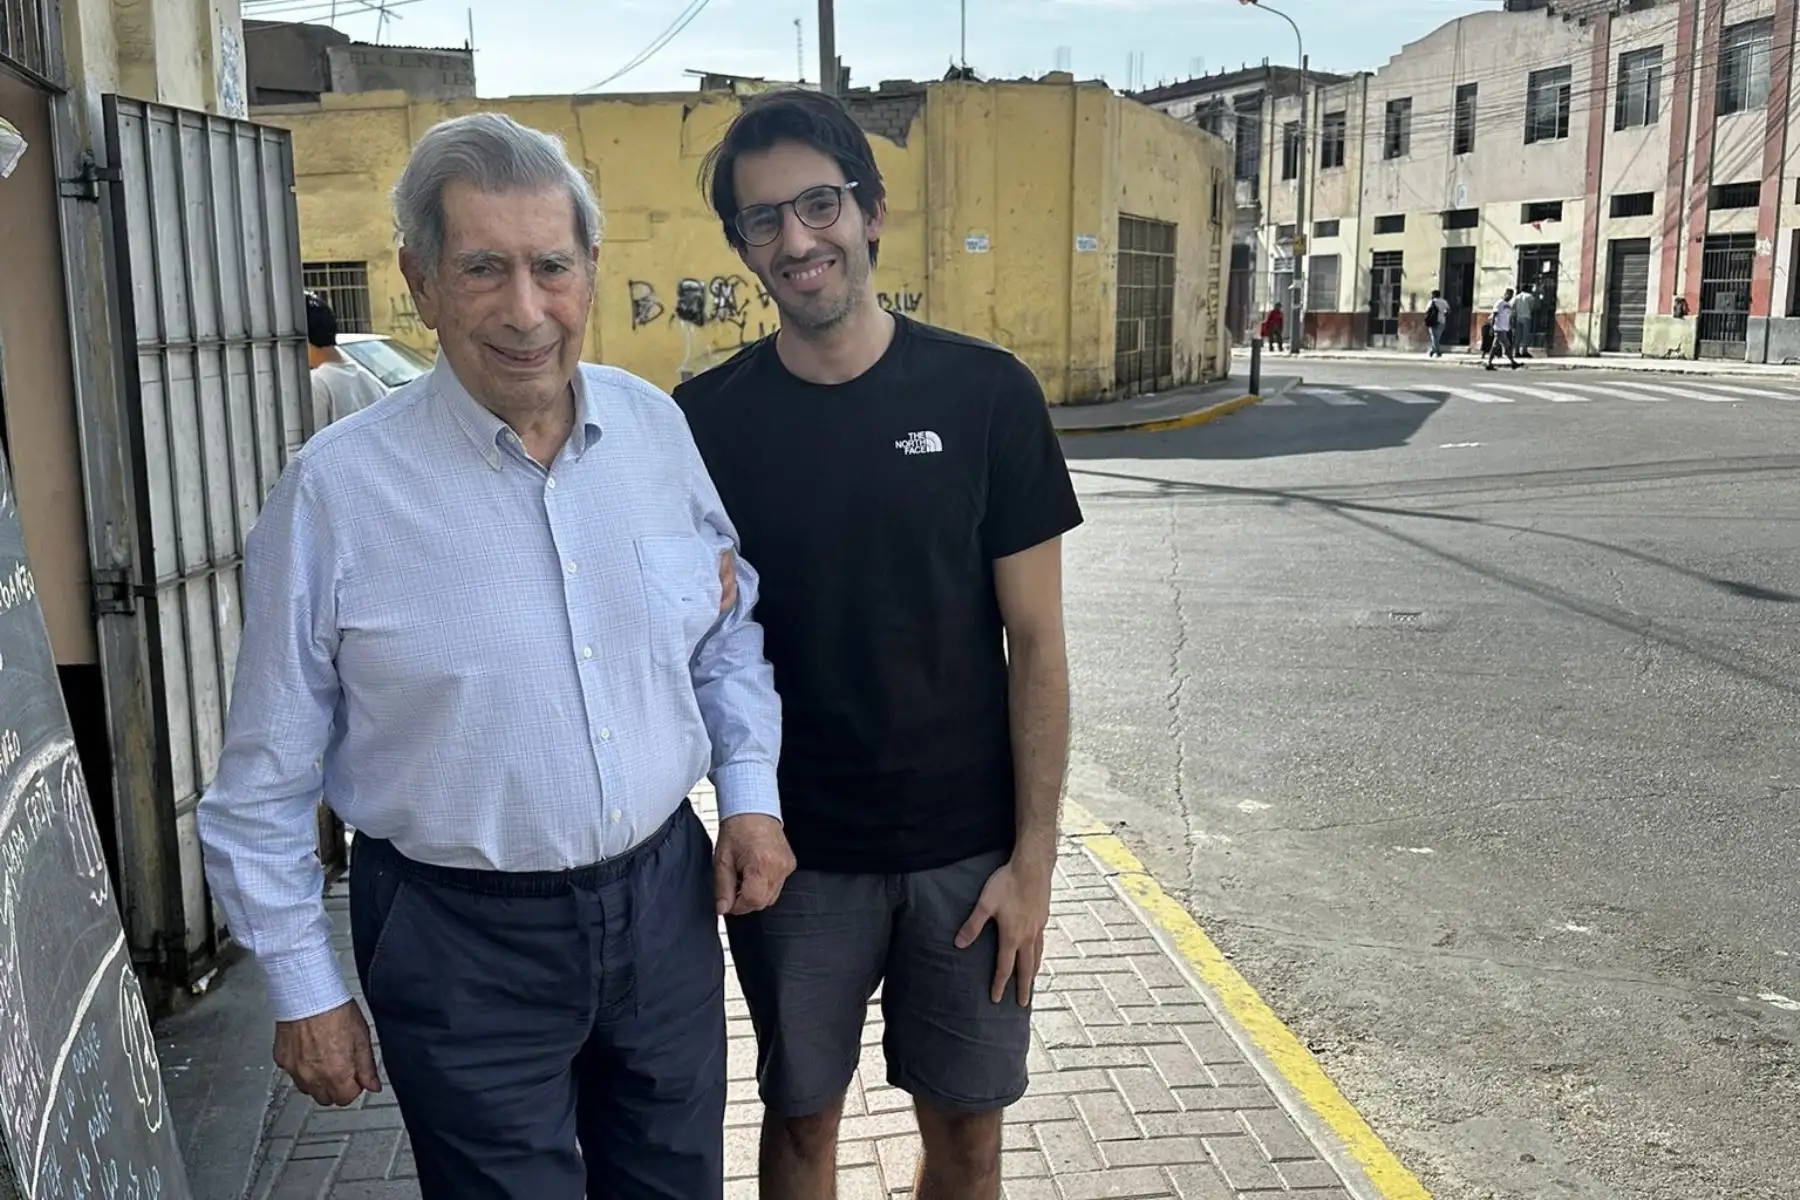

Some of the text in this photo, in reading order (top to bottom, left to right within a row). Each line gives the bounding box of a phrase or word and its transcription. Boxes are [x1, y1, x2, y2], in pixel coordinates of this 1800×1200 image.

[908, 431, 926, 440] THE
[895, 440, 927, 449] NORTH
[904, 447, 927, 455] FACE
